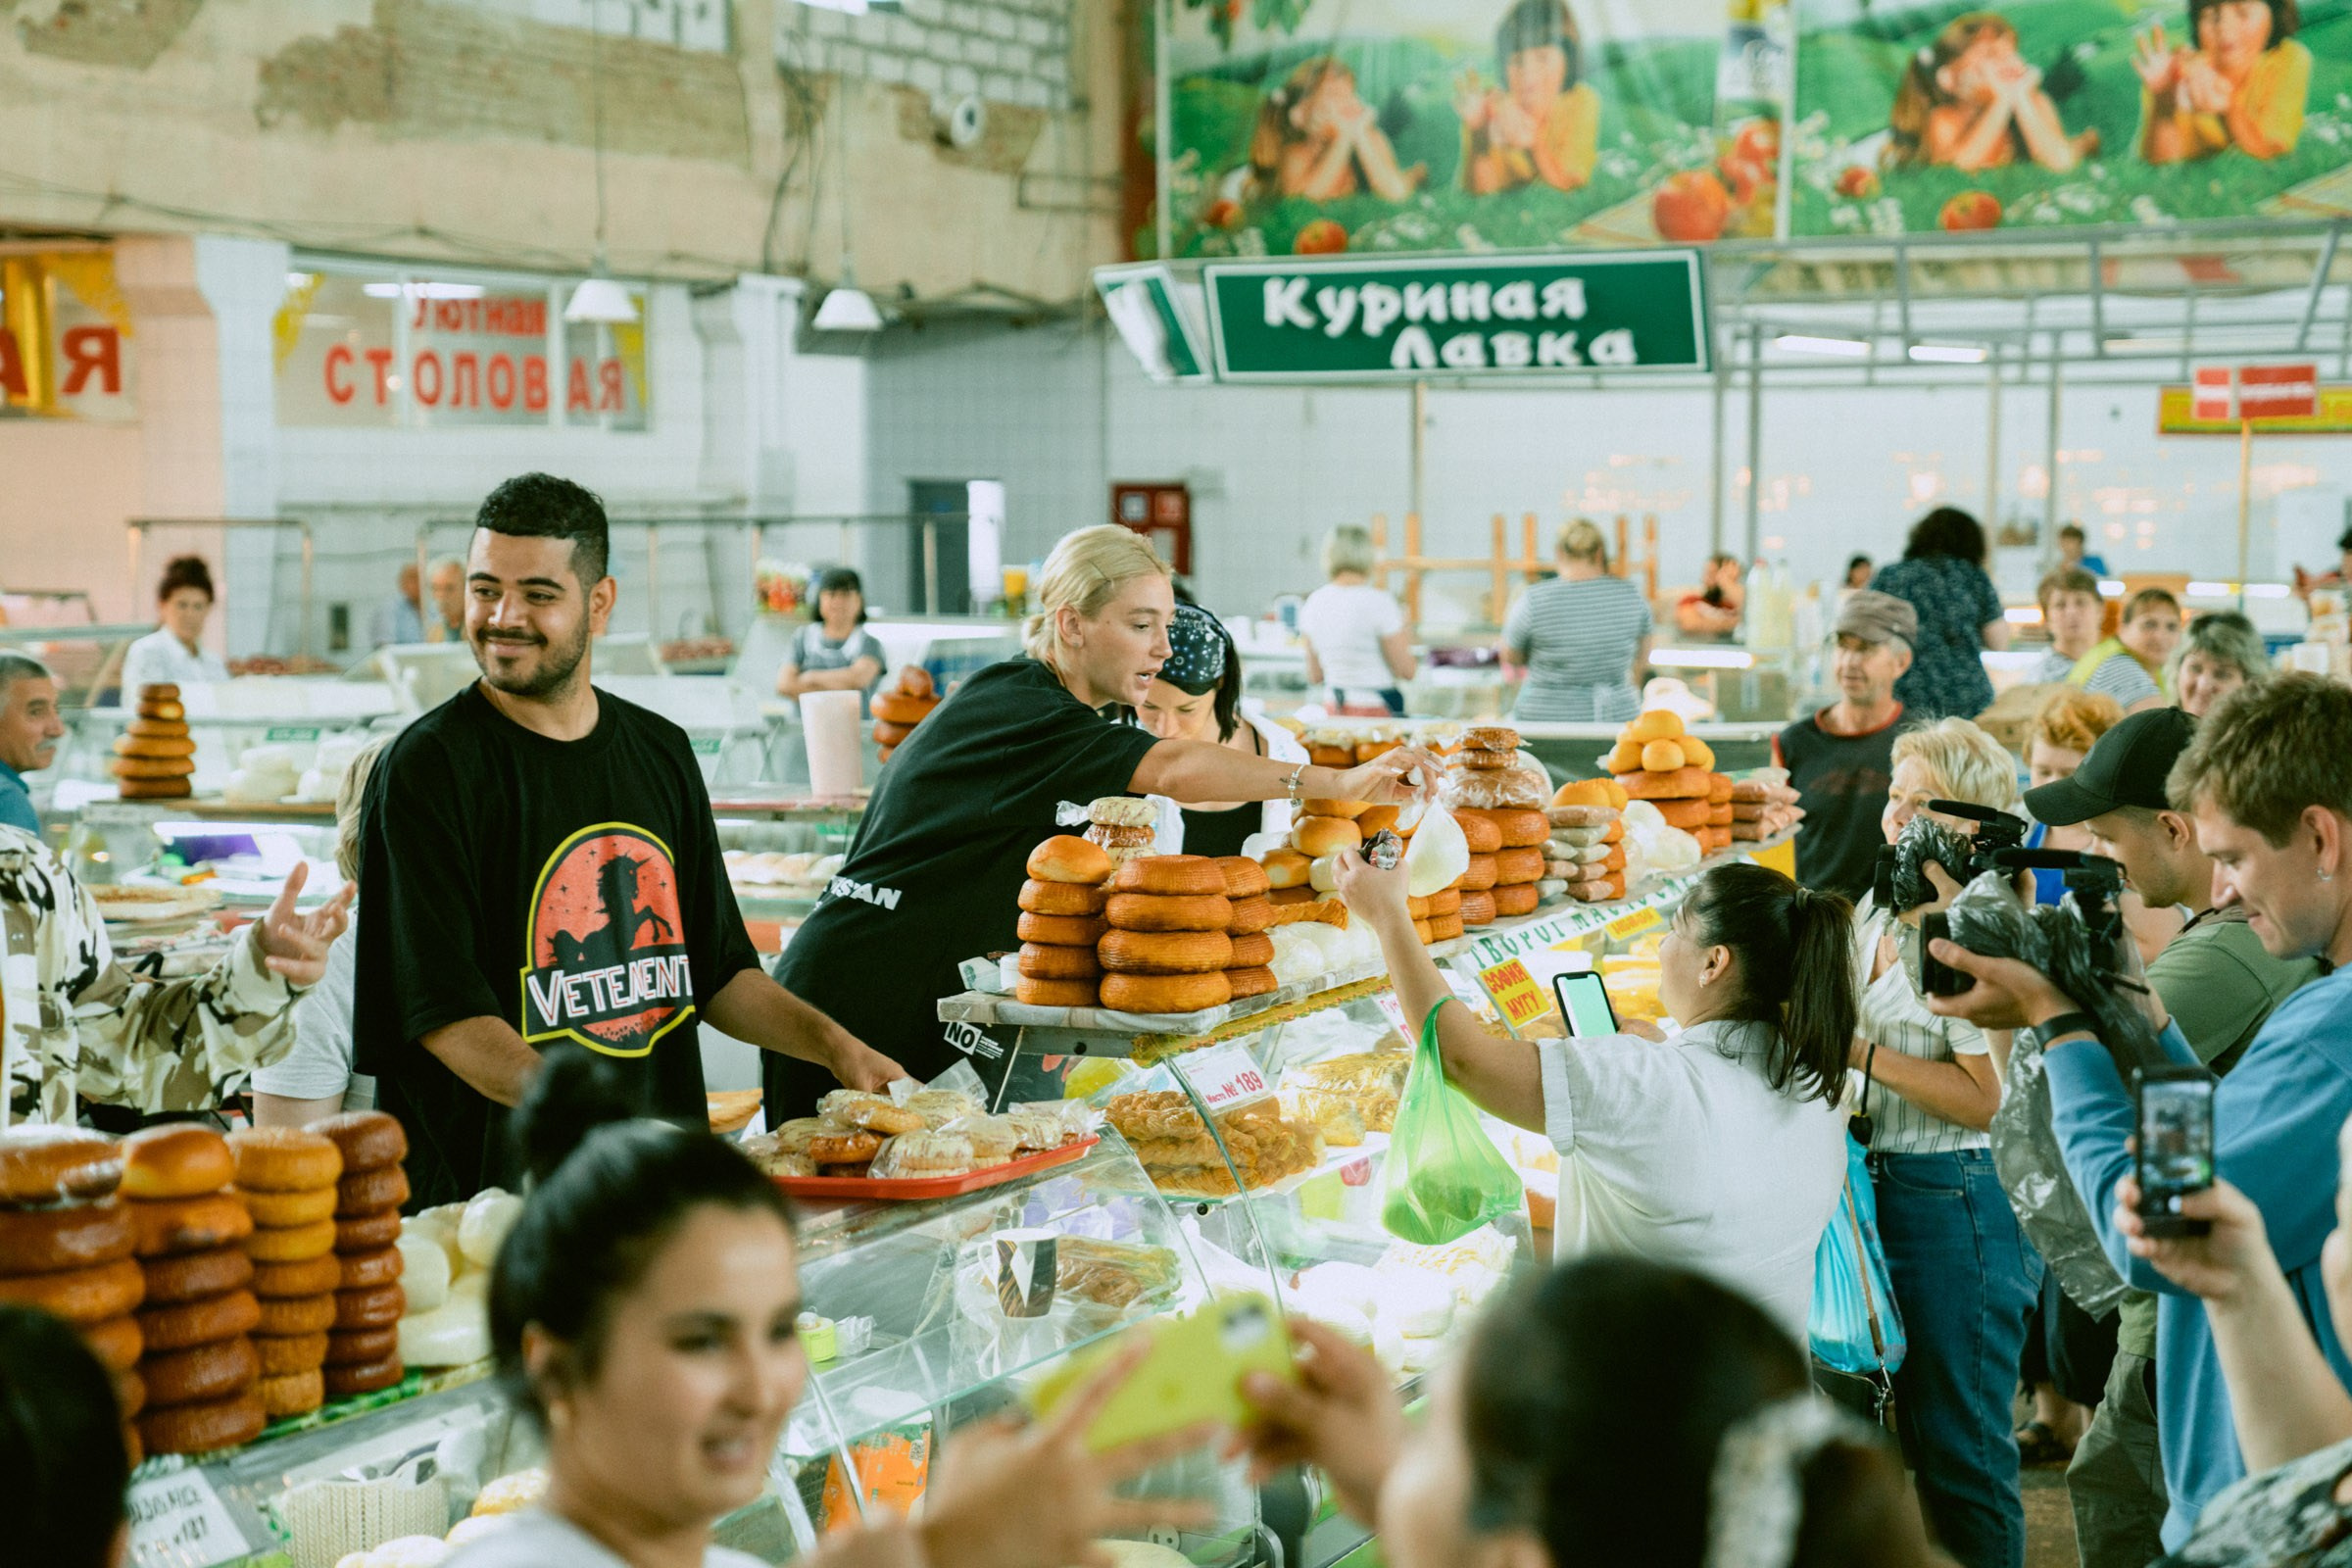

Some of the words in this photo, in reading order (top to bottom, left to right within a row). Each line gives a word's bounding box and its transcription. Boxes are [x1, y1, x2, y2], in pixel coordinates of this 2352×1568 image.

[1263, 276, 1588, 338] Куриная
[1390, 324, 1639, 369] Лавка
[323, 344, 624, 414] СТОЛОВАЯ
[947, 1022, 976, 1049] NO
[1235, 1070, 1263, 1094] 189
